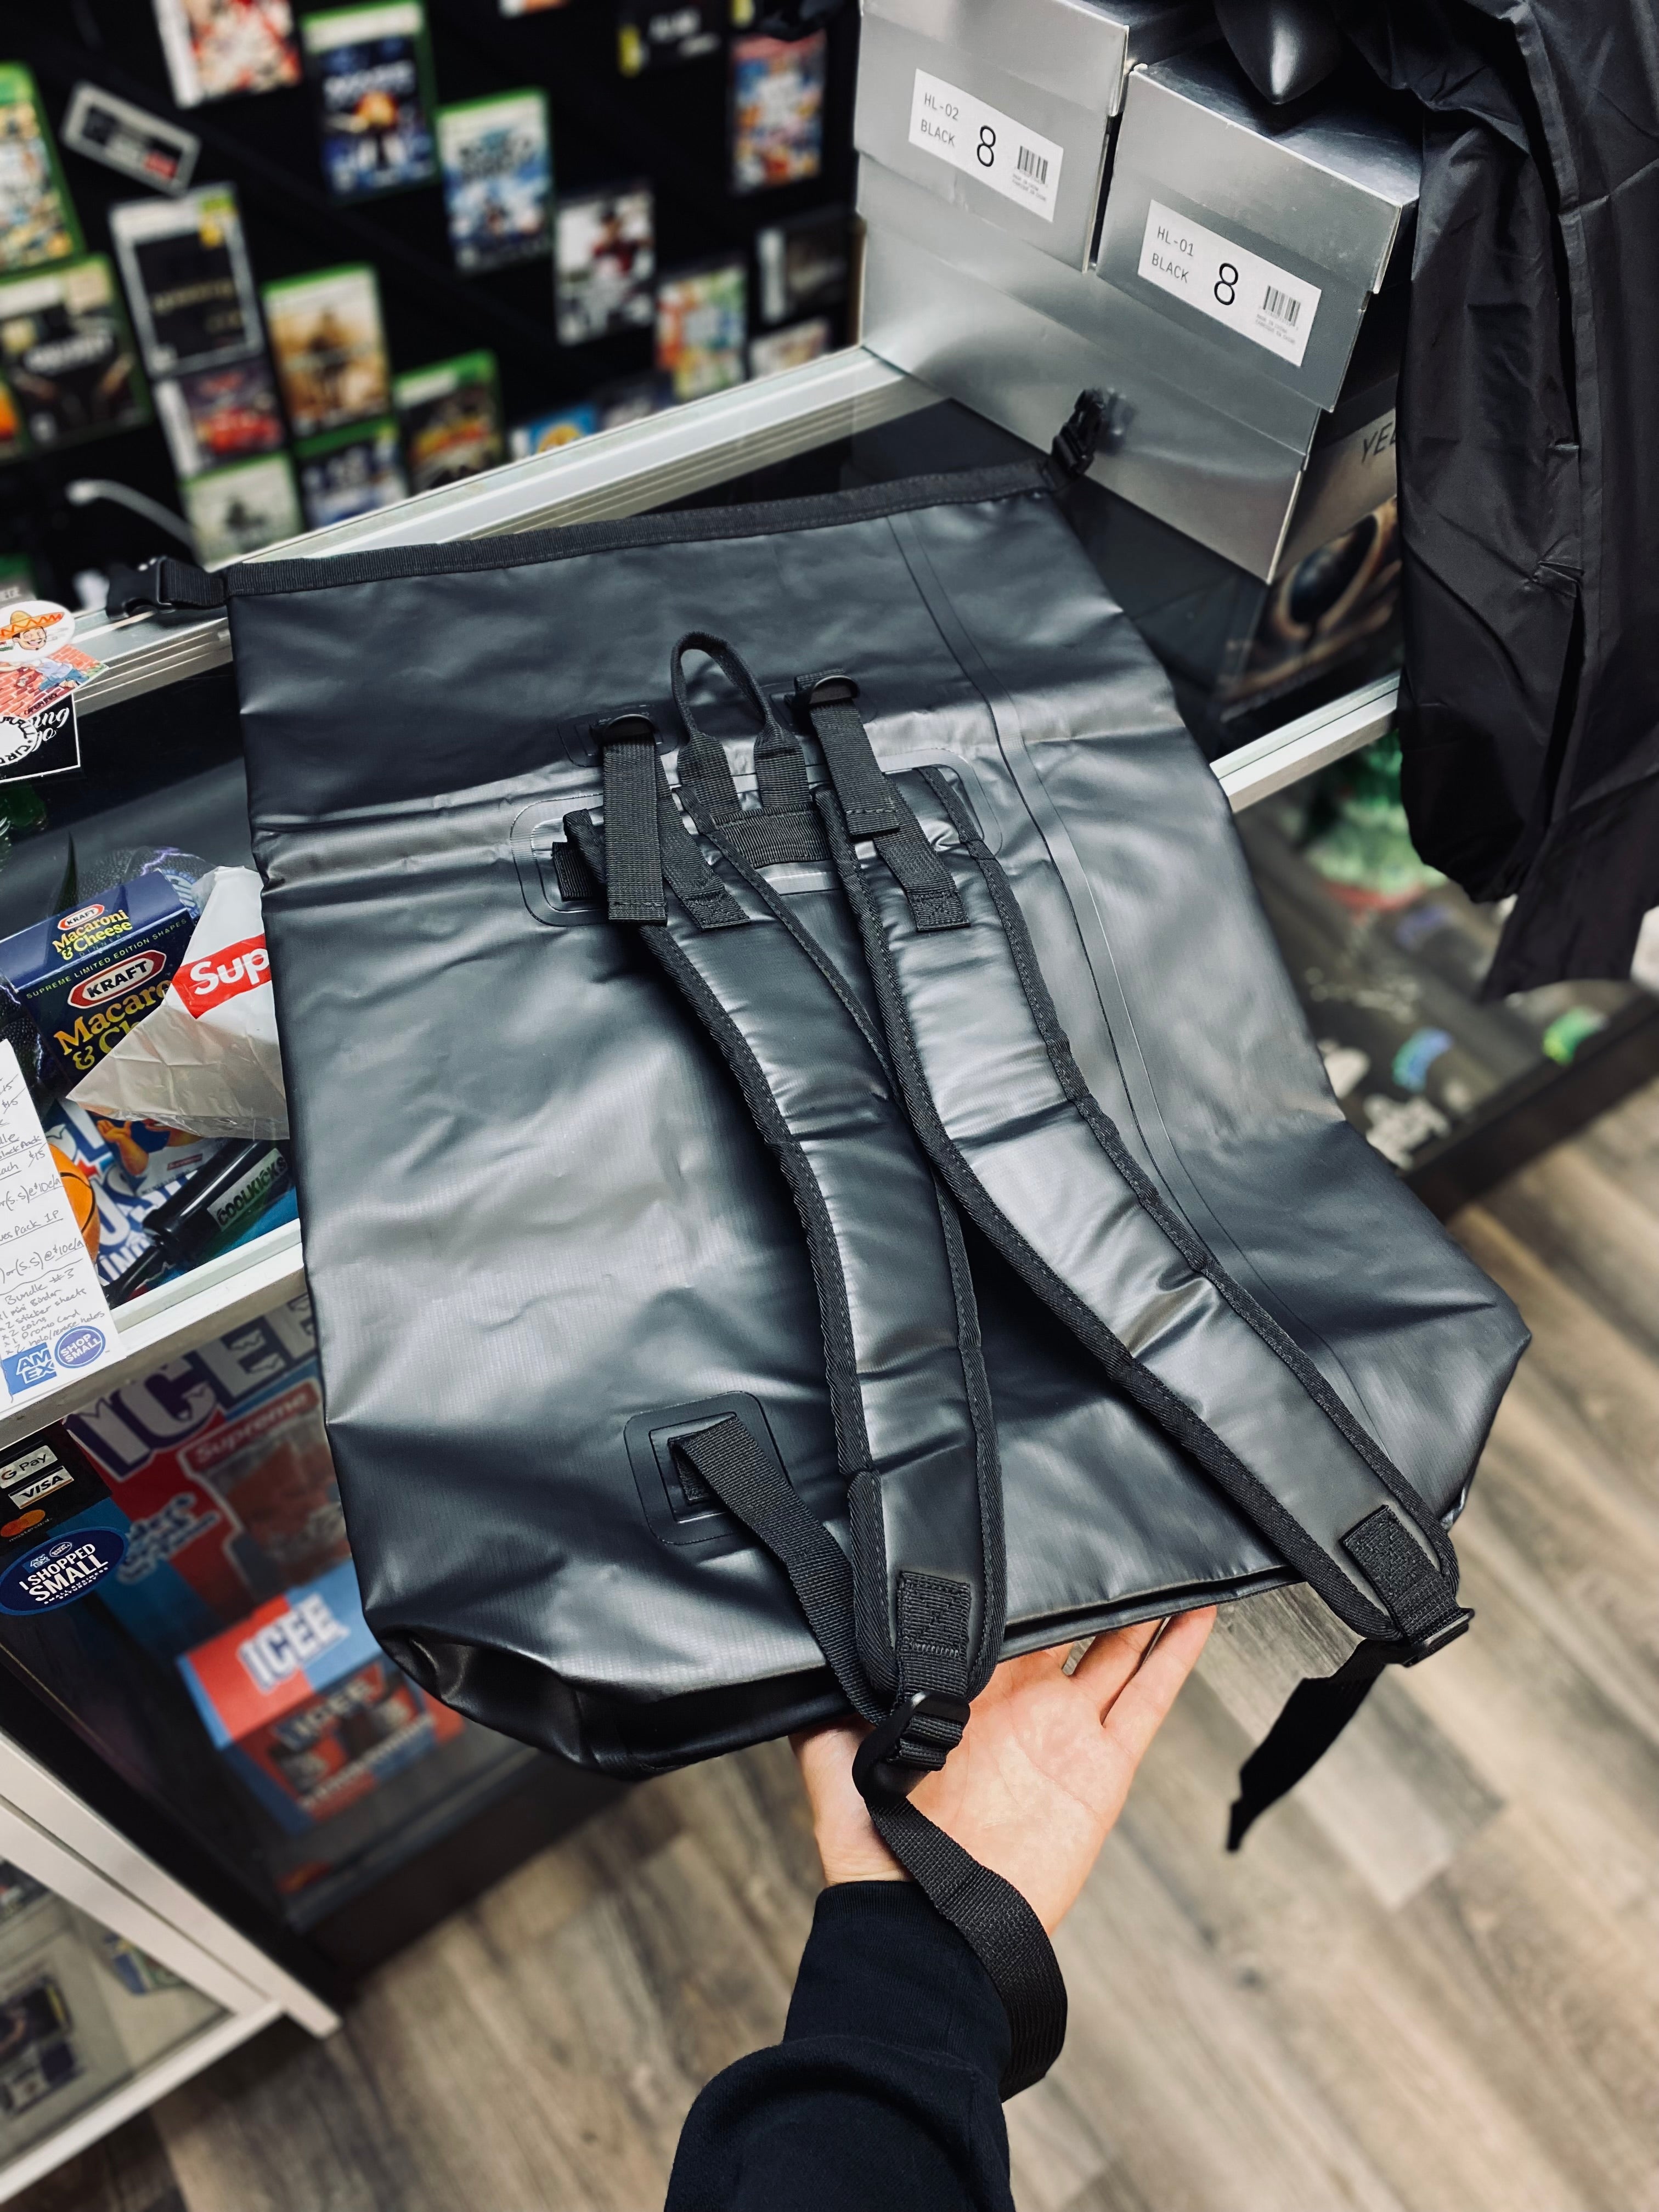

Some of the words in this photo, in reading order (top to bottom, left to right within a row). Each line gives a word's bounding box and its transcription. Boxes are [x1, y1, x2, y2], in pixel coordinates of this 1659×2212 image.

[924, 92, 960, 121] HL-02
[921, 119, 956, 148] BLACK
[977, 125, 996, 167] 8
[1157, 225, 1194, 256] HL-01
[1152, 252, 1189, 283] BLACK
[1214, 262, 1239, 306] 8
[52, 910, 129, 953] Macaroni
[66, 908, 96, 925] KRAFT
[61, 947, 74, 960] &
[73, 921, 133, 952] Cheese
[26, 975, 71, 999] SUPREME
[74, 957, 111, 978] LIMITED
[113, 938, 150, 959] EDITION
[152, 918, 187, 940] SHAPES
[190, 948, 270, 995] Sup
[87, 960, 147, 998] KRAFT
[72, 1046, 95, 1070] &
[5, 1284, 48, 1305] Bundle
[60, 1333, 92, 1356] SHOP
[65, 1339, 101, 1363] SMALL
[19, 1454, 47, 1471] Pay
[19, 1475, 64, 1498] VISA
[19, 1581, 29, 1590] I
[27, 1544, 95, 1585] SHOPPED
[29, 1554, 109, 1601] SMALL
[239, 1593, 351, 1695] ICEE
